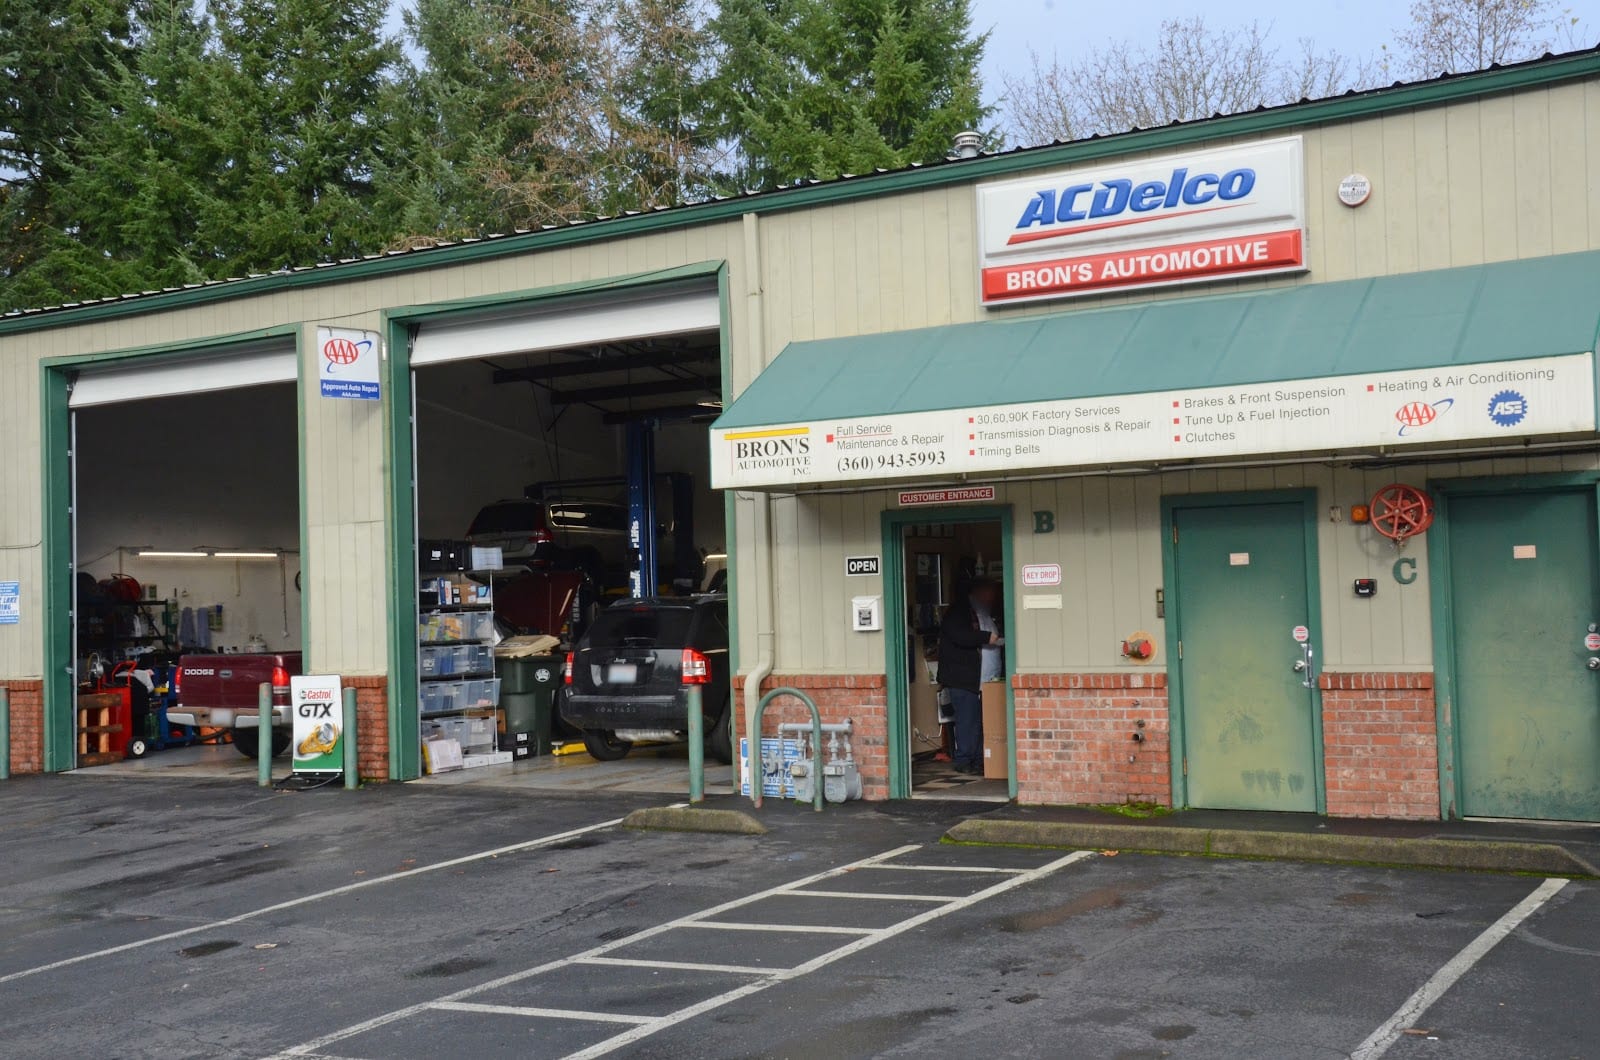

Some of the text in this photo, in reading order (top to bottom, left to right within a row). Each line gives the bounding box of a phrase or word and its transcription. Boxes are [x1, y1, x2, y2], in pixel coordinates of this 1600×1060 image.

[1016, 168, 1256, 229] ACDelco
[1007, 241, 1268, 291] BRON'S AUTOMOTIVE
[328, 339, 356, 364] AAA
[322, 383, 378, 393] Approved Auto Repair
[1379, 368, 1555, 393] Heating & Air Conditioning
[1184, 387, 1346, 409] Brakes & Front Suspension
[977, 406, 1120, 425] 30,60,90K Factory Services
[1185, 406, 1330, 426] Tune Up & Fuel Injection
[1398, 402, 1433, 426] AAA
[1493, 401, 1523, 416] ASE
[836, 424, 893, 437] Full Service
[979, 420, 1151, 441] Transmission Diagnosis & Repair
[1185, 431, 1236, 443] Clutches
[736, 437, 810, 459] BRON'S
[837, 434, 944, 450] Maintenance & Repair
[978, 444, 1041, 457] Timing Belts
[737, 456, 811, 471] AUTOMOTIVE
[837, 451, 946, 472] (360) 943-5993
[793, 467, 811, 476] INC.
[902, 489, 991, 503] CUSTOMER ENTRANCE
[1033, 510, 1055, 534] B
[849, 560, 876, 572] OPEN
[1392, 557, 1417, 584] C
[1040, 571, 1057, 579] DROP
[184, 668, 215, 676] DODGE
[307, 690, 332, 700] Castrol
[298, 702, 334, 719] GTX
